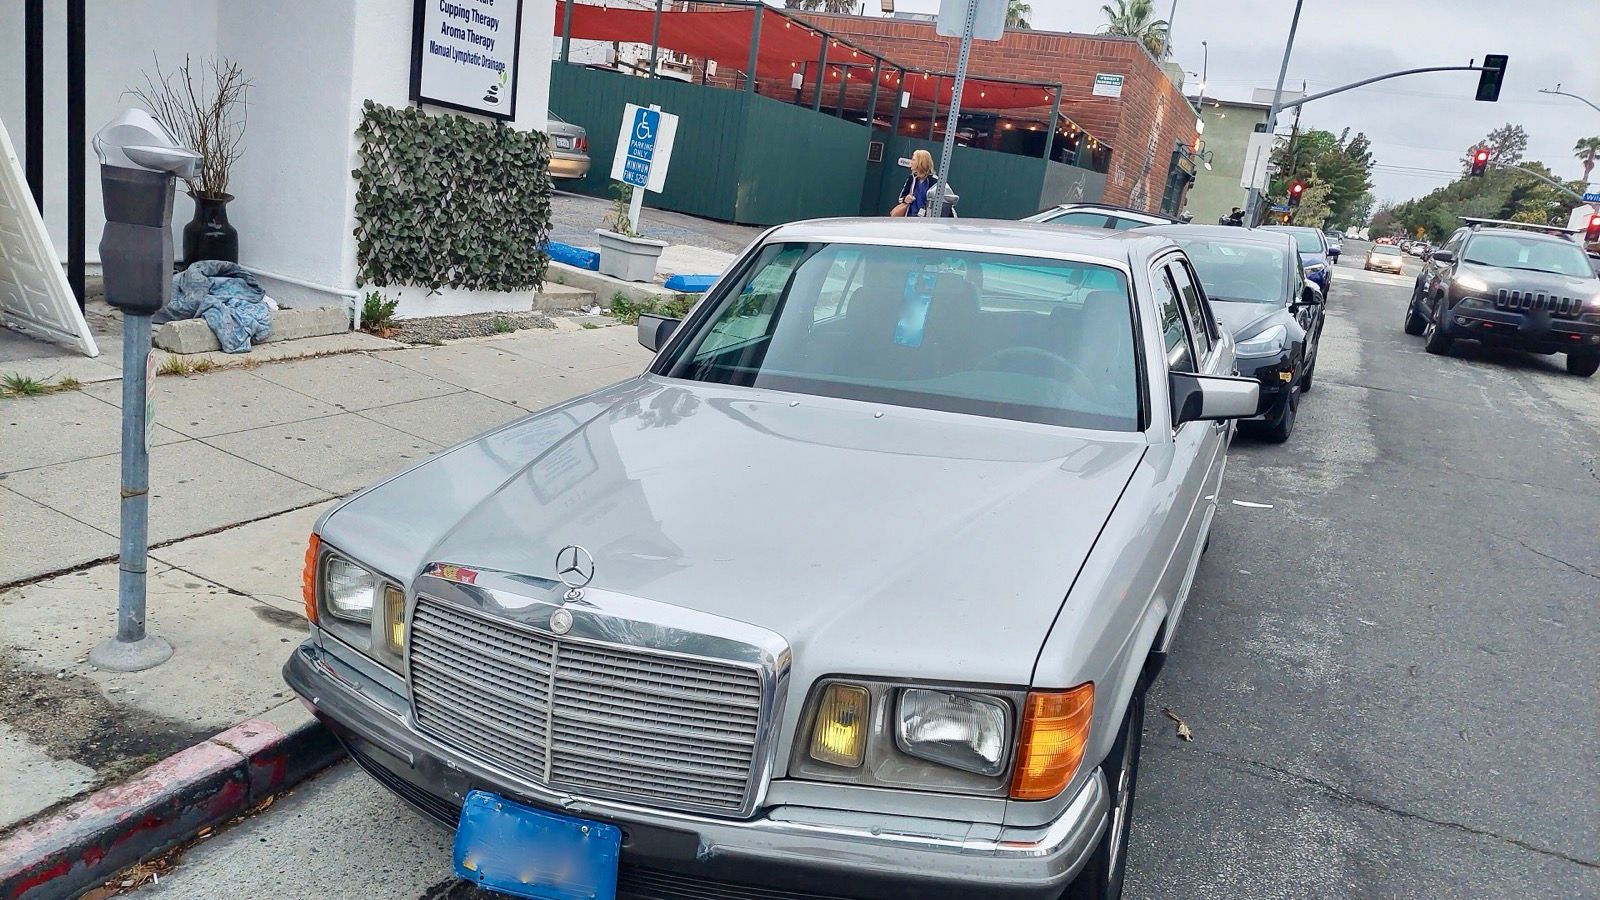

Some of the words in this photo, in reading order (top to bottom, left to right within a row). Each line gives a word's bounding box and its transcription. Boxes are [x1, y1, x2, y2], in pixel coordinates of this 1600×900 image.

[439, 0, 470, 23] Cupping
[471, 9, 499, 32] Therapy
[441, 21, 465, 40] Aroma
[467, 29, 495, 51] Therapy
[430, 40, 452, 58] Manual
[452, 46, 481, 66] Lymphatic
[481, 54, 505, 74] Drainage
[630, 139, 654, 152] PARKING
[633, 148, 648, 158] ONLY
[626, 159, 649, 172] MINIMUM
[624, 169, 635, 181] FINE
[635, 172, 648, 184] $250
